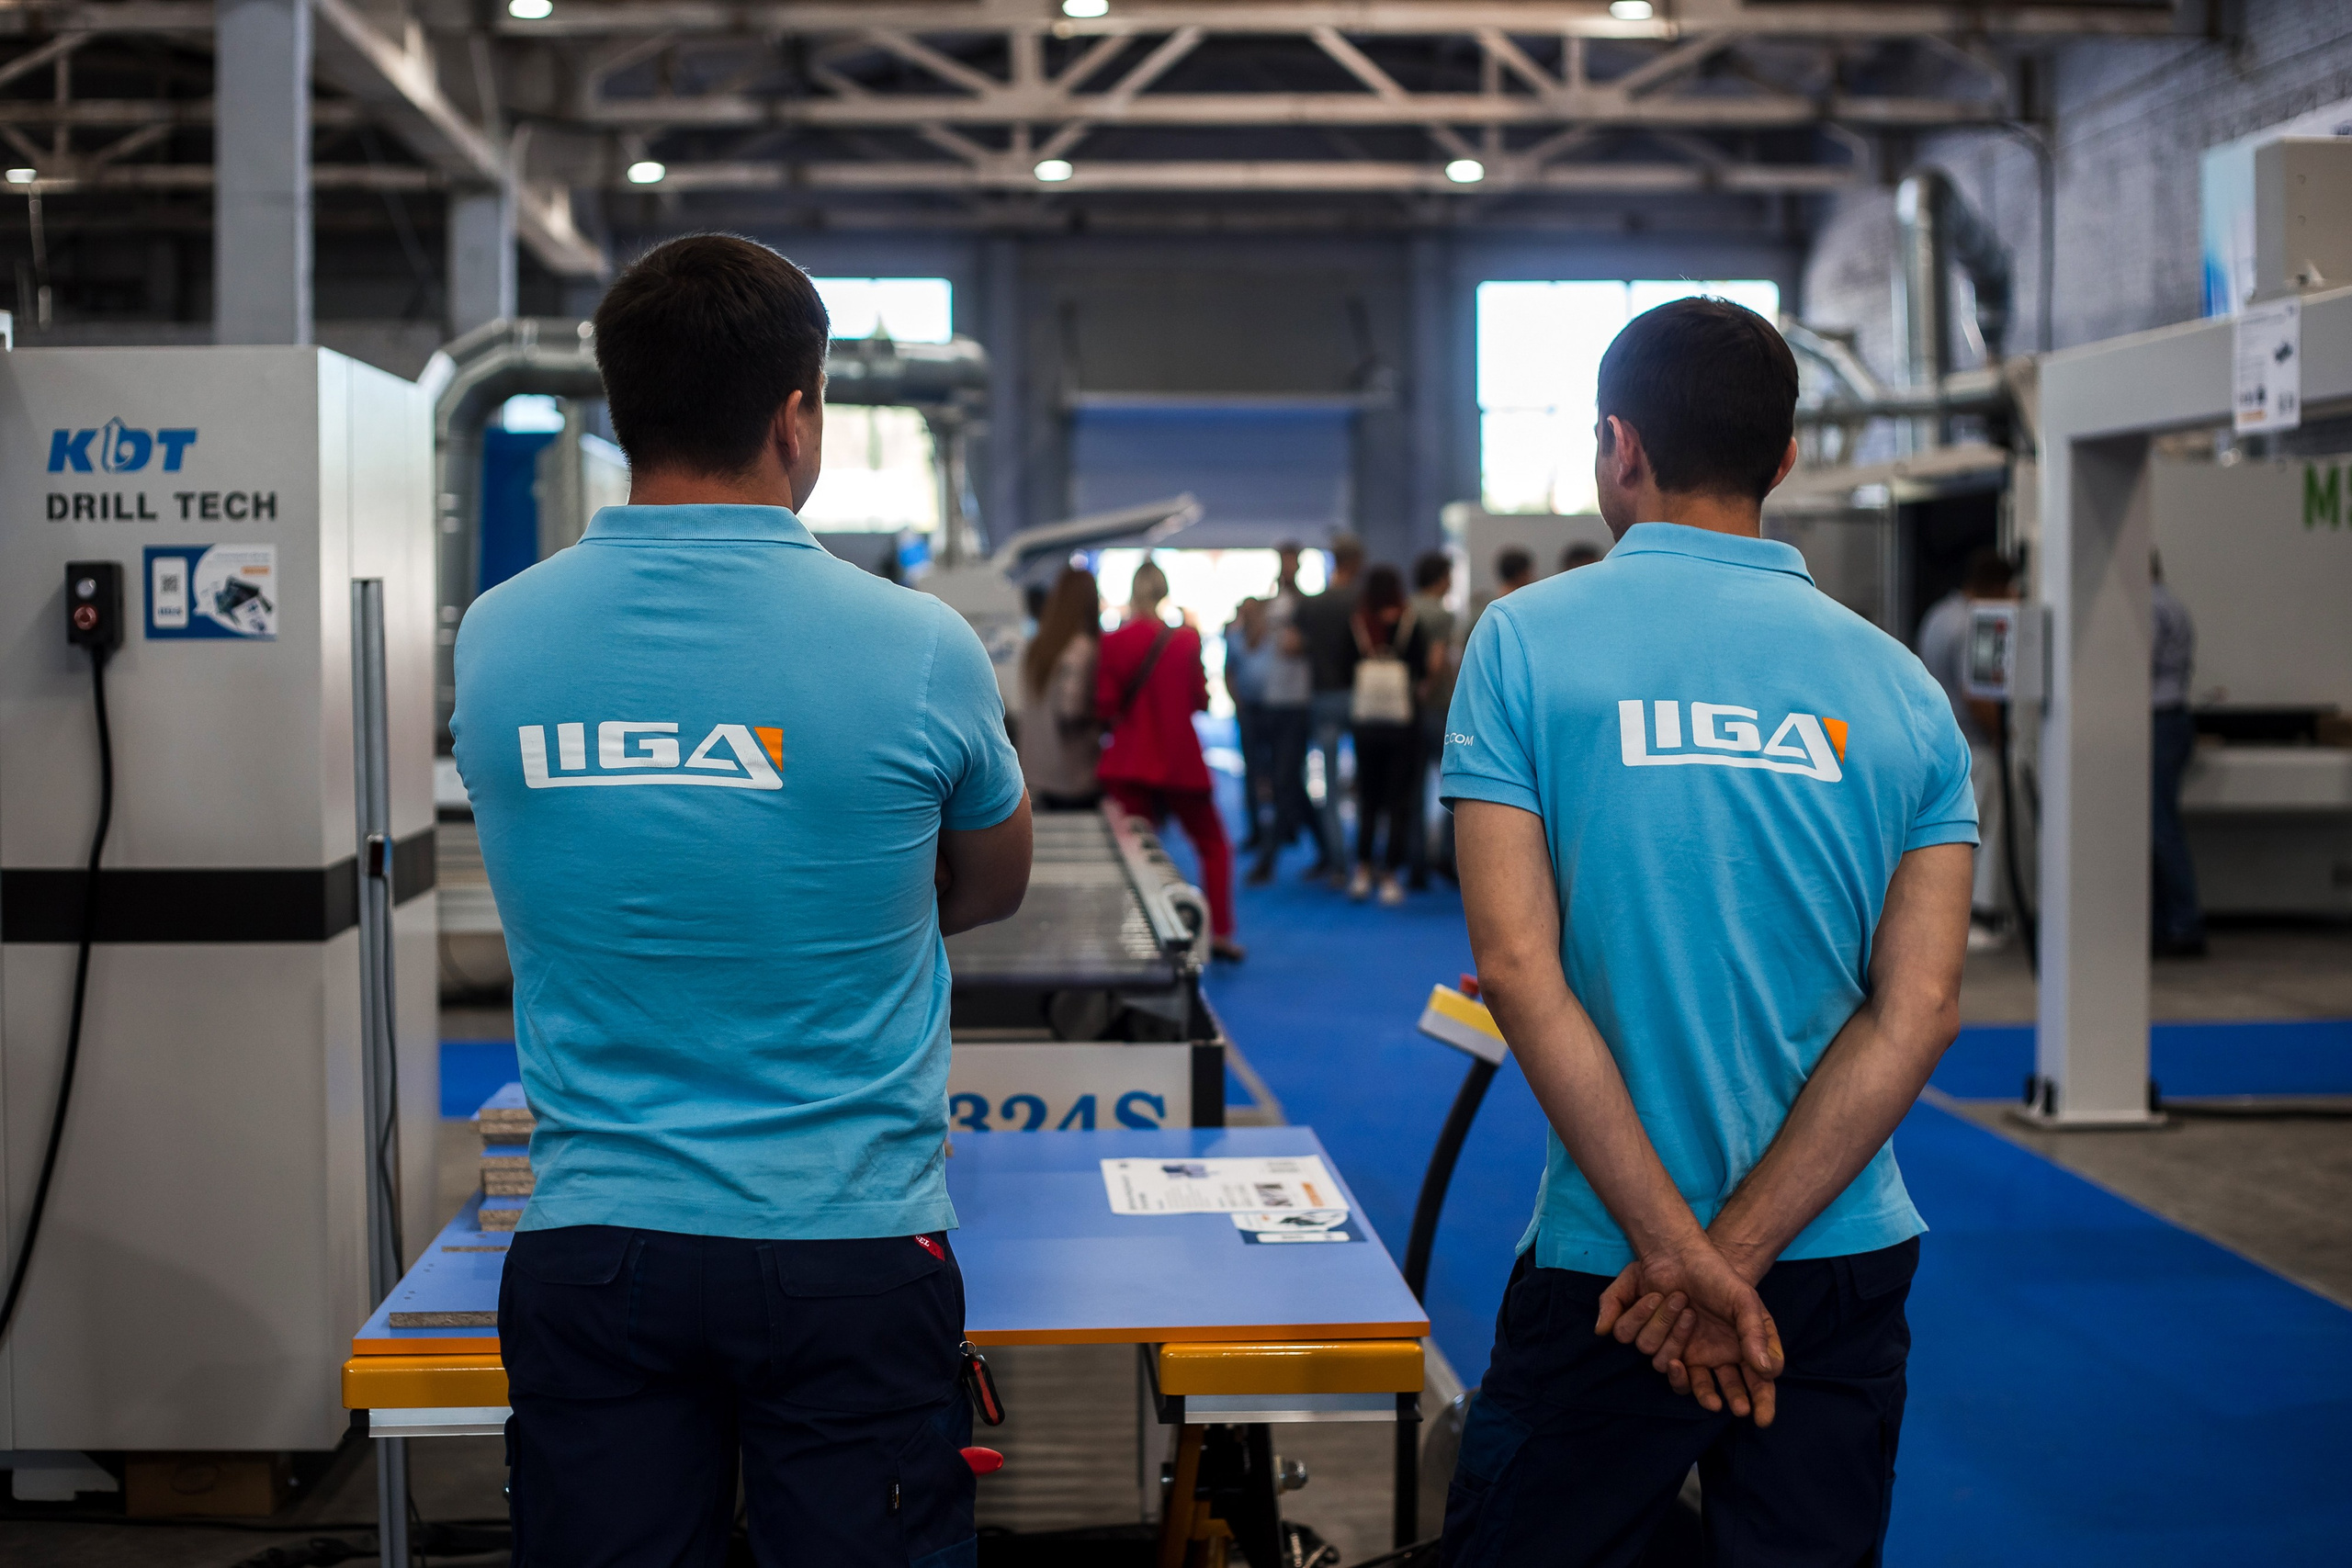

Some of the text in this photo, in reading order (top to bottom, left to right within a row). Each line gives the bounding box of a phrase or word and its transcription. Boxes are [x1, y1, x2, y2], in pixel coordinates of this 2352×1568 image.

[47, 491, 277, 521] DRILL TECH
[518, 721, 784, 791] LIGA
[1618, 699, 1848, 783] LIGA
